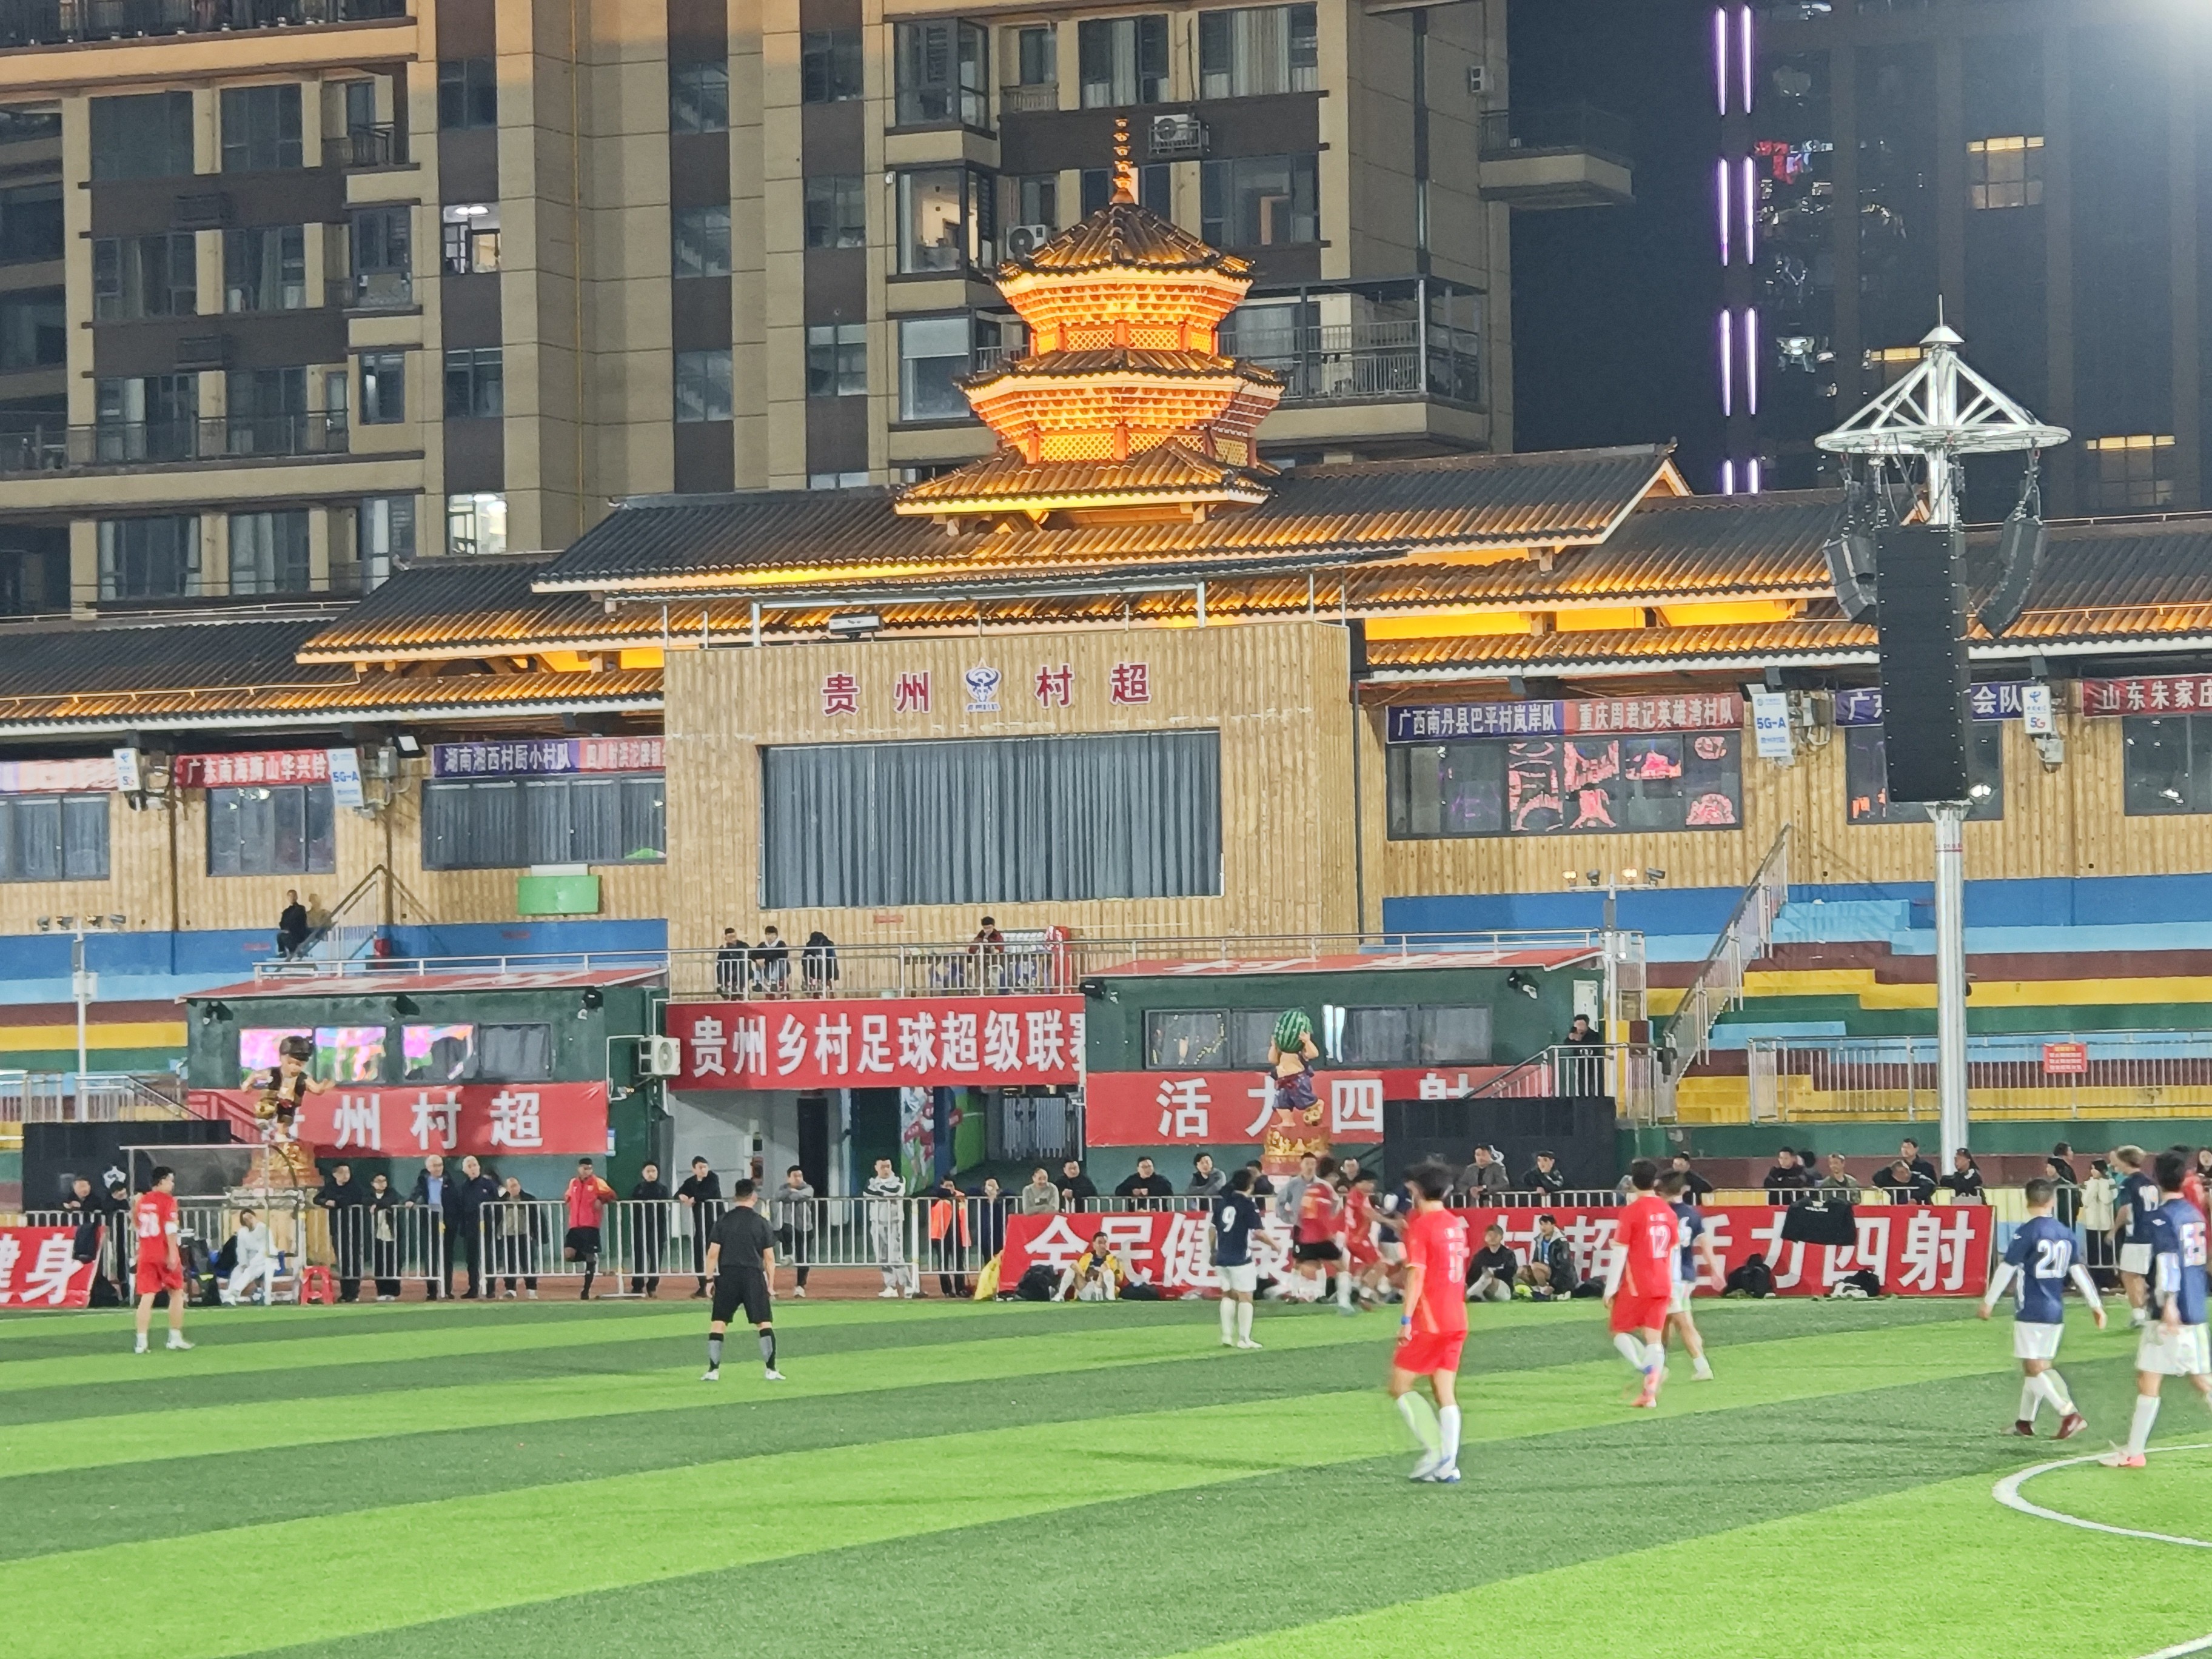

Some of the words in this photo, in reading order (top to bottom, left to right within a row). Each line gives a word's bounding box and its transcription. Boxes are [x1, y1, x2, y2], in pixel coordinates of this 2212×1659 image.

[822, 672, 930, 715] 贵州
[1036, 663, 1151, 707] 村超
[1757, 717, 1786, 729] 5G-A
[2029, 717, 2046, 729] 5G
[332, 771, 359, 782] 5G-A
[1221, 1205, 1236, 1232] 9
[1649, 1224, 1671, 1259] 12
[2036, 1239, 2073, 1279] 20
